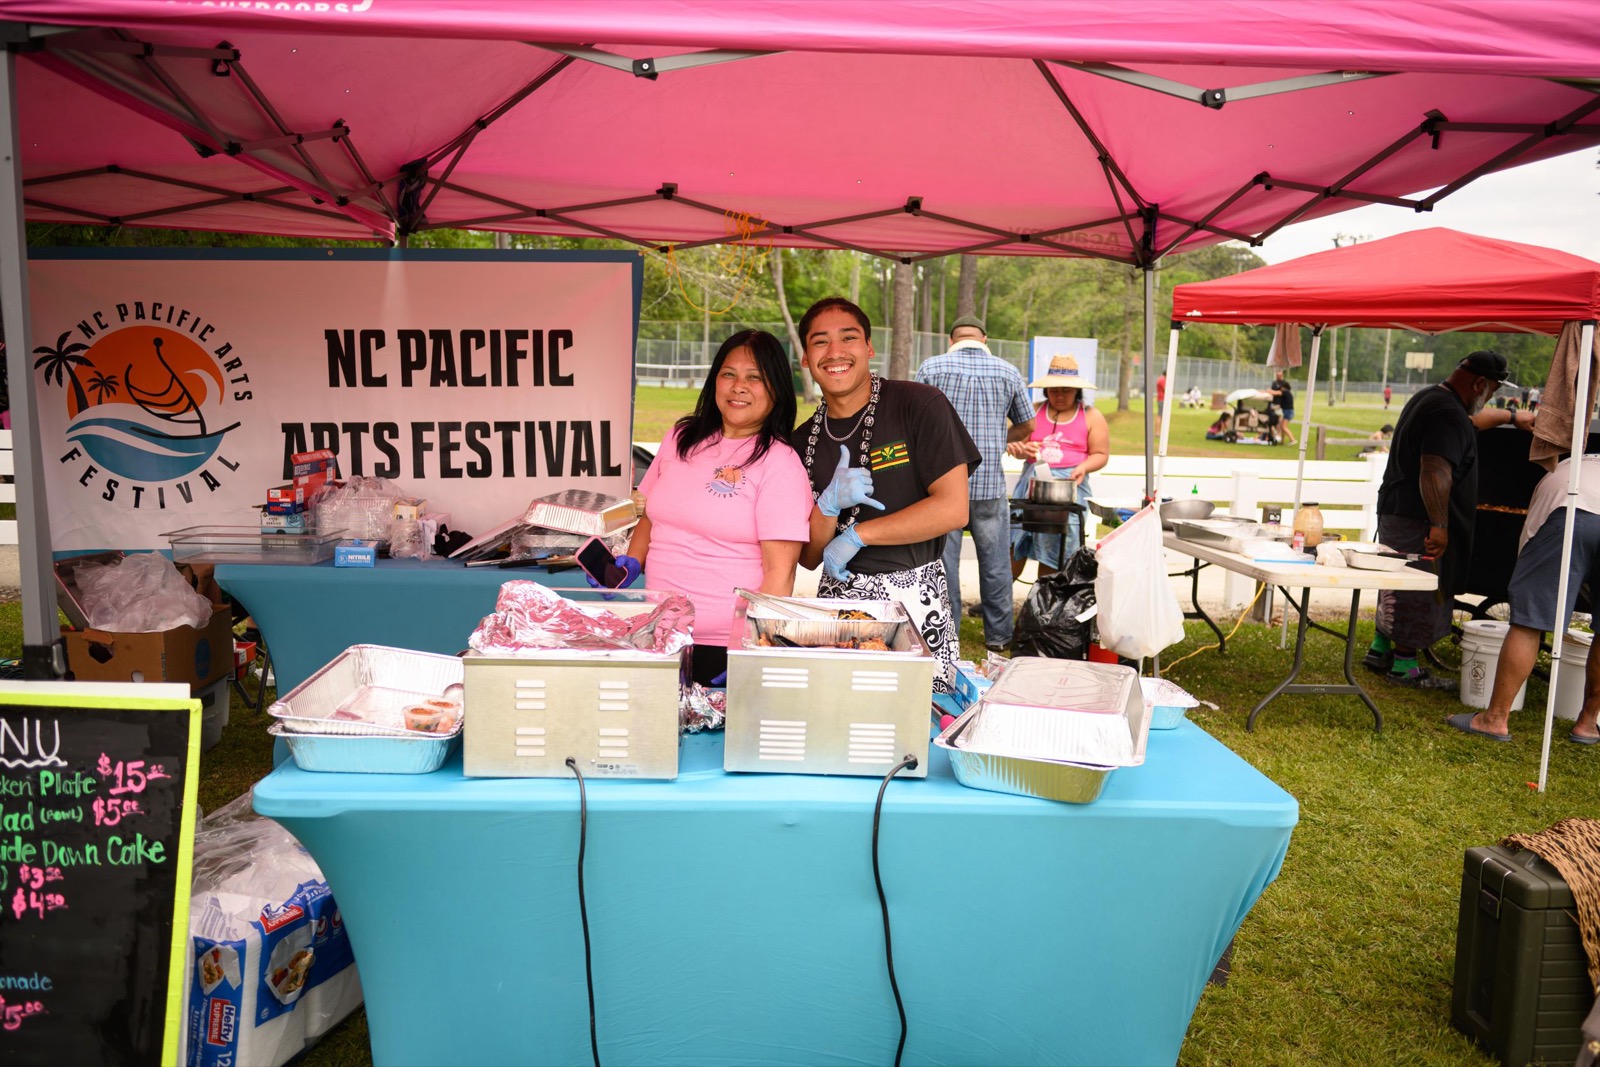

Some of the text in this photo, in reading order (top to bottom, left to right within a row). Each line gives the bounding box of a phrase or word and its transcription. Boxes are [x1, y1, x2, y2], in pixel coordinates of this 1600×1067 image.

[77, 301, 253, 401] NC PACIFIC ARTS
[324, 329, 574, 387] NC PACIFIC
[281, 420, 621, 480] ARTS FESTIVAL
[60, 447, 240, 509] FESTIVAL
[0, 774, 33, 796] ken
[40, 770, 96, 798] Plate
[42, 840, 101, 866] Down
[107, 833, 167, 864] Cake
[211, 1002, 221, 1040] SUPREME
[221, 1005, 235, 1041] Hefty
